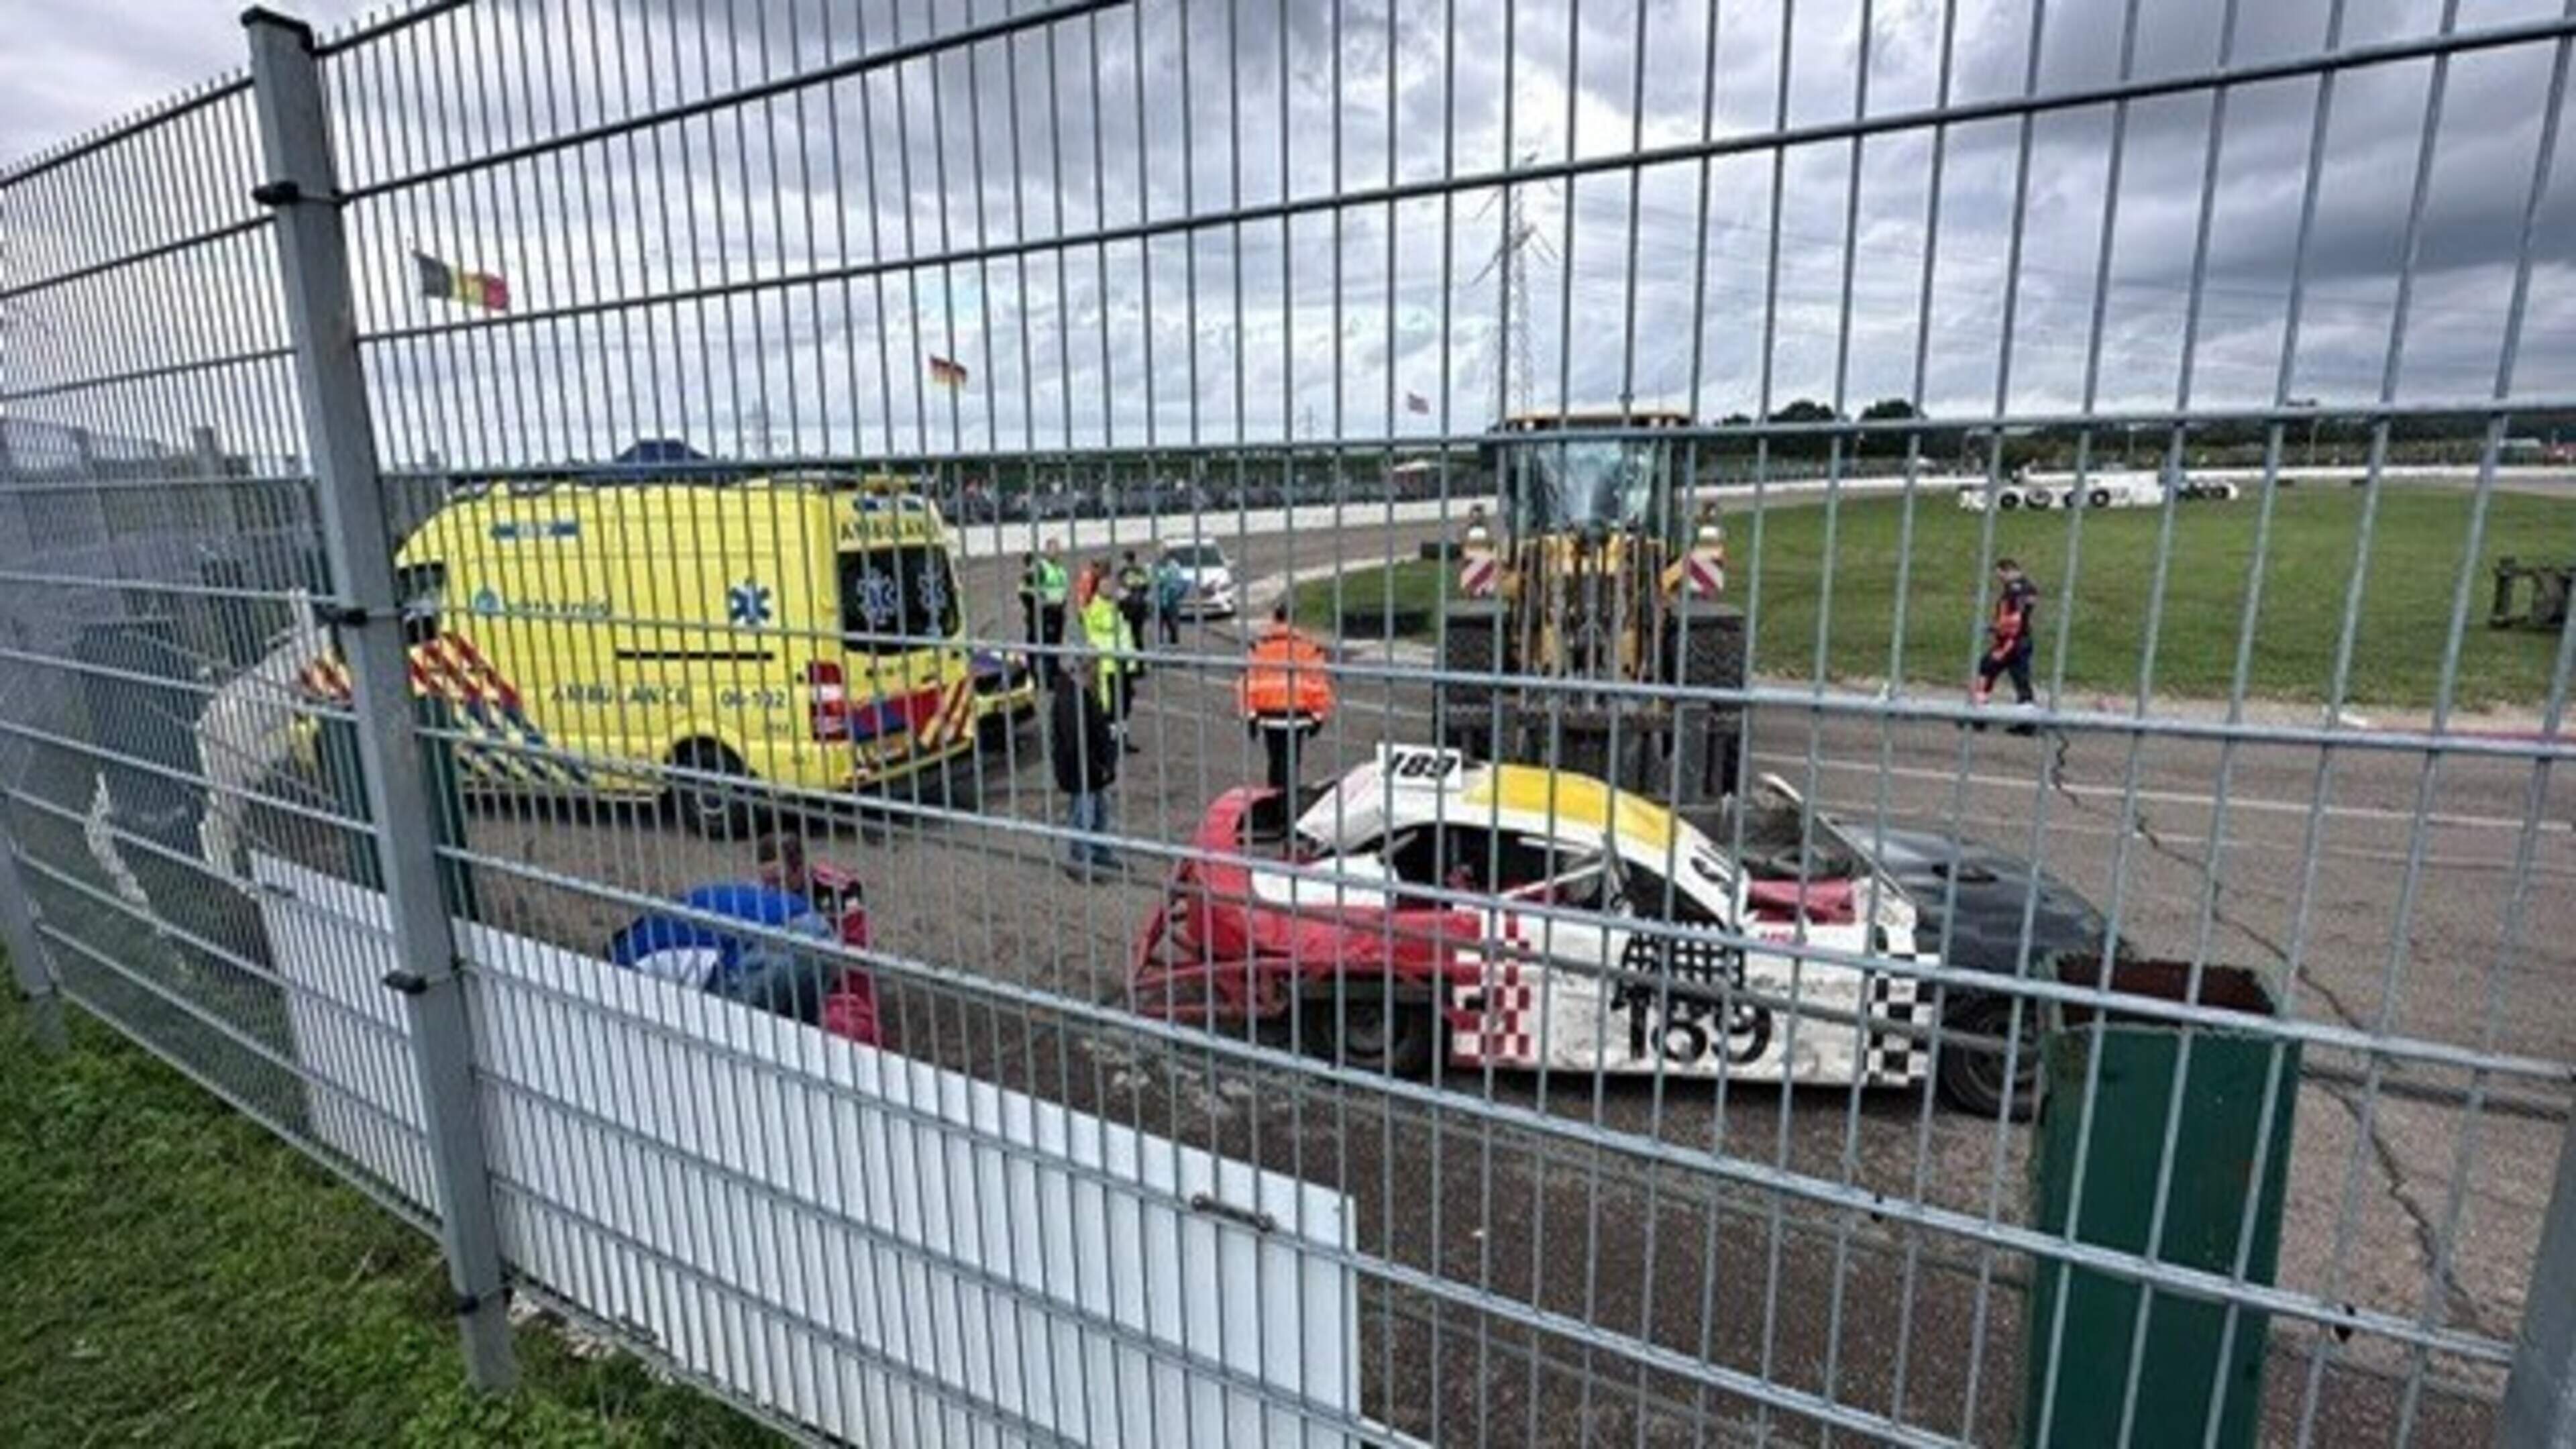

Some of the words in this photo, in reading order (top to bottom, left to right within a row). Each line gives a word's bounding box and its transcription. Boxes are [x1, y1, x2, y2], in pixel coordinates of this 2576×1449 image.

[551, 684, 691, 705] AMBUANE
[1382, 752, 1458, 781] 189
[1625, 982, 1772, 1064] 189
